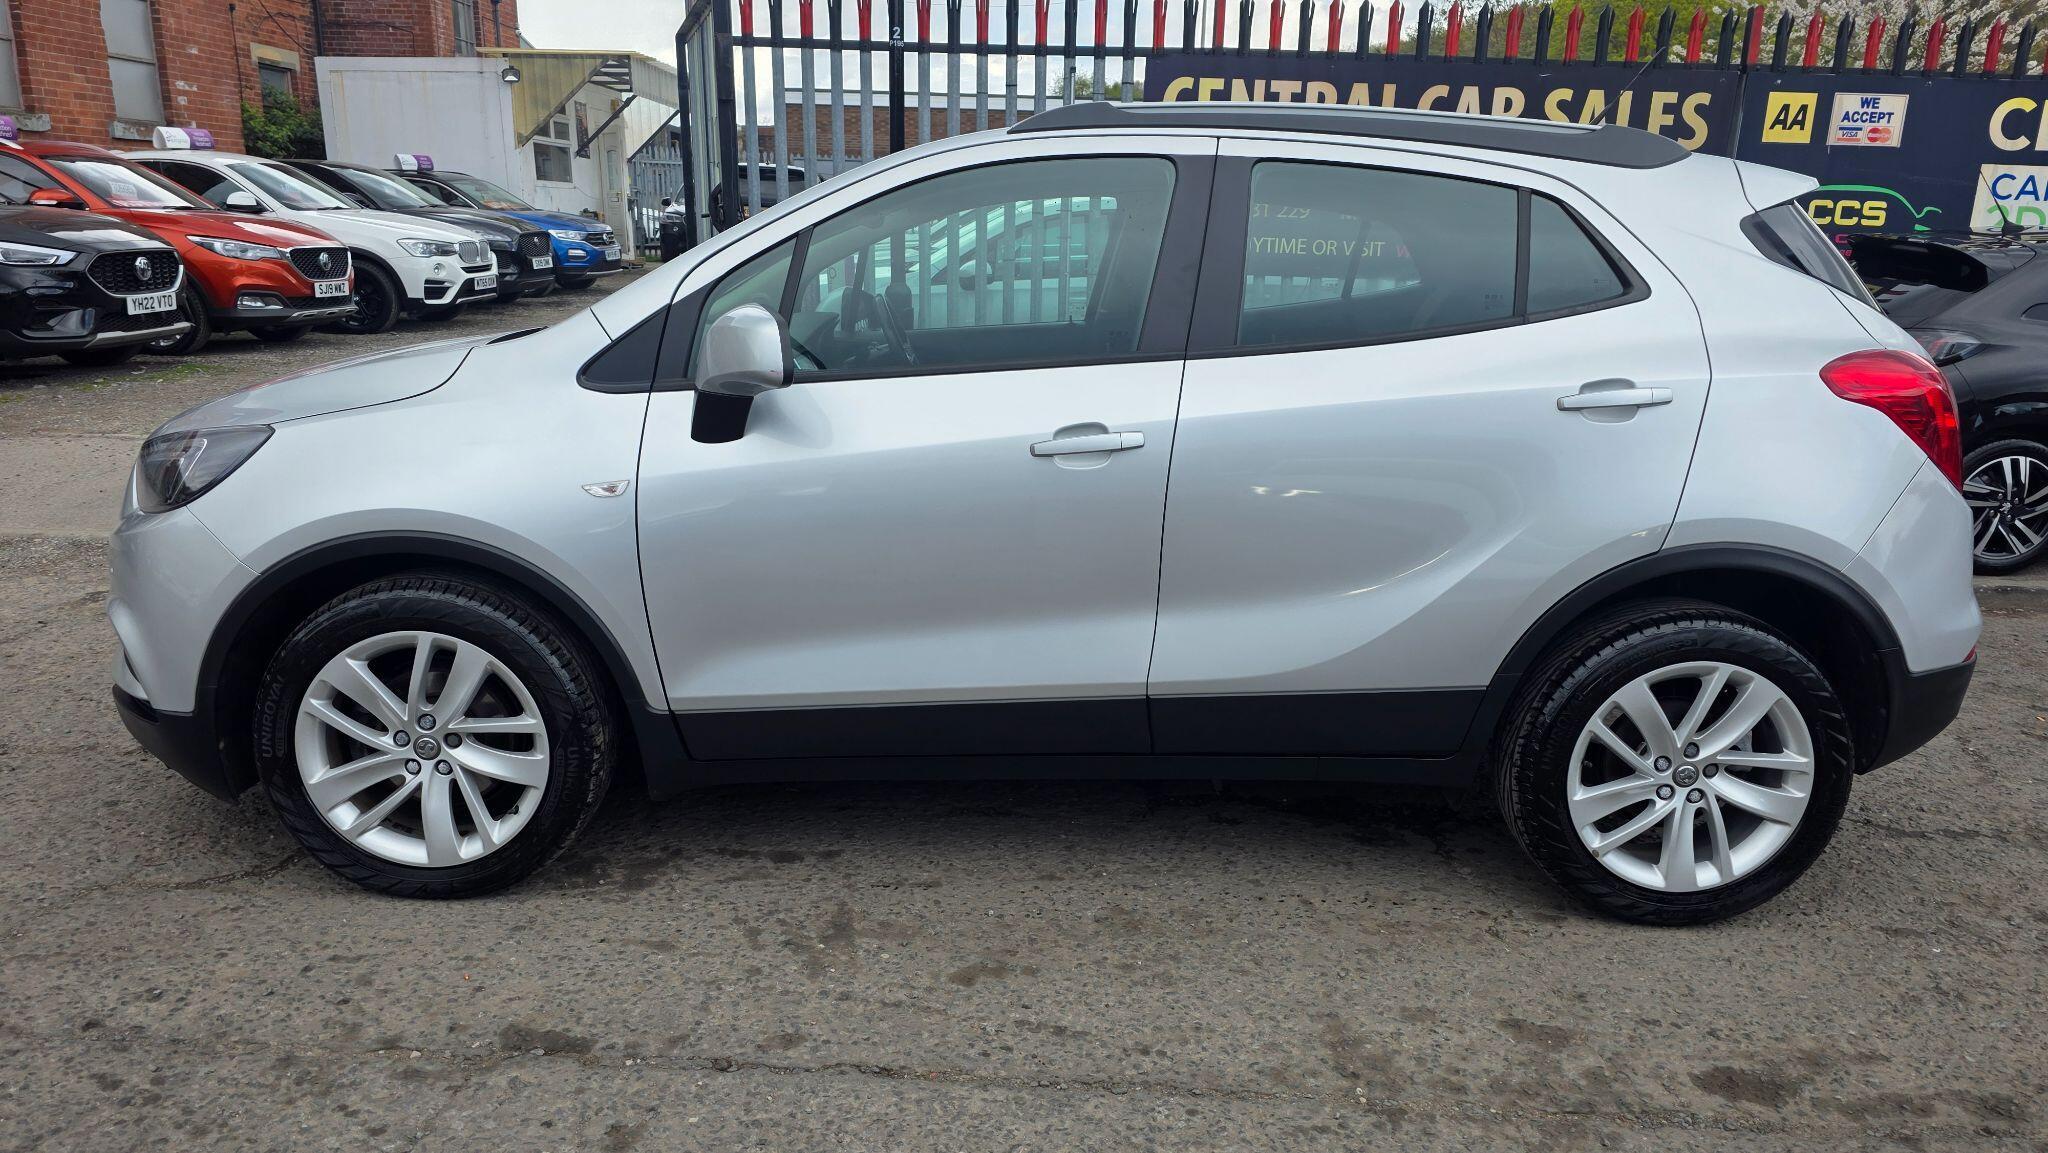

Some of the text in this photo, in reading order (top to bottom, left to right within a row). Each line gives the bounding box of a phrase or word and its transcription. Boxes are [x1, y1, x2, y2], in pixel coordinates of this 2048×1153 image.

[892, 26, 901, 39] 2
[1860, 97, 1881, 109] WE
[1544, 88, 1712, 151] SALES
[1769, 103, 1809, 131] AA
[1841, 111, 1894, 124] ACCEPT
[1989, 97, 2048, 151] C
[1991, 173, 2048, 201] CA
[1808, 199, 1888, 227] CCS
[1250, 237, 1308, 255] YTIME
[1312, 239, 1338, 256] OR
[1343, 241, 1386, 257] VSIT
[319, 284, 333, 294] SJ19
[132, 294, 173, 311] YH22 VTO
